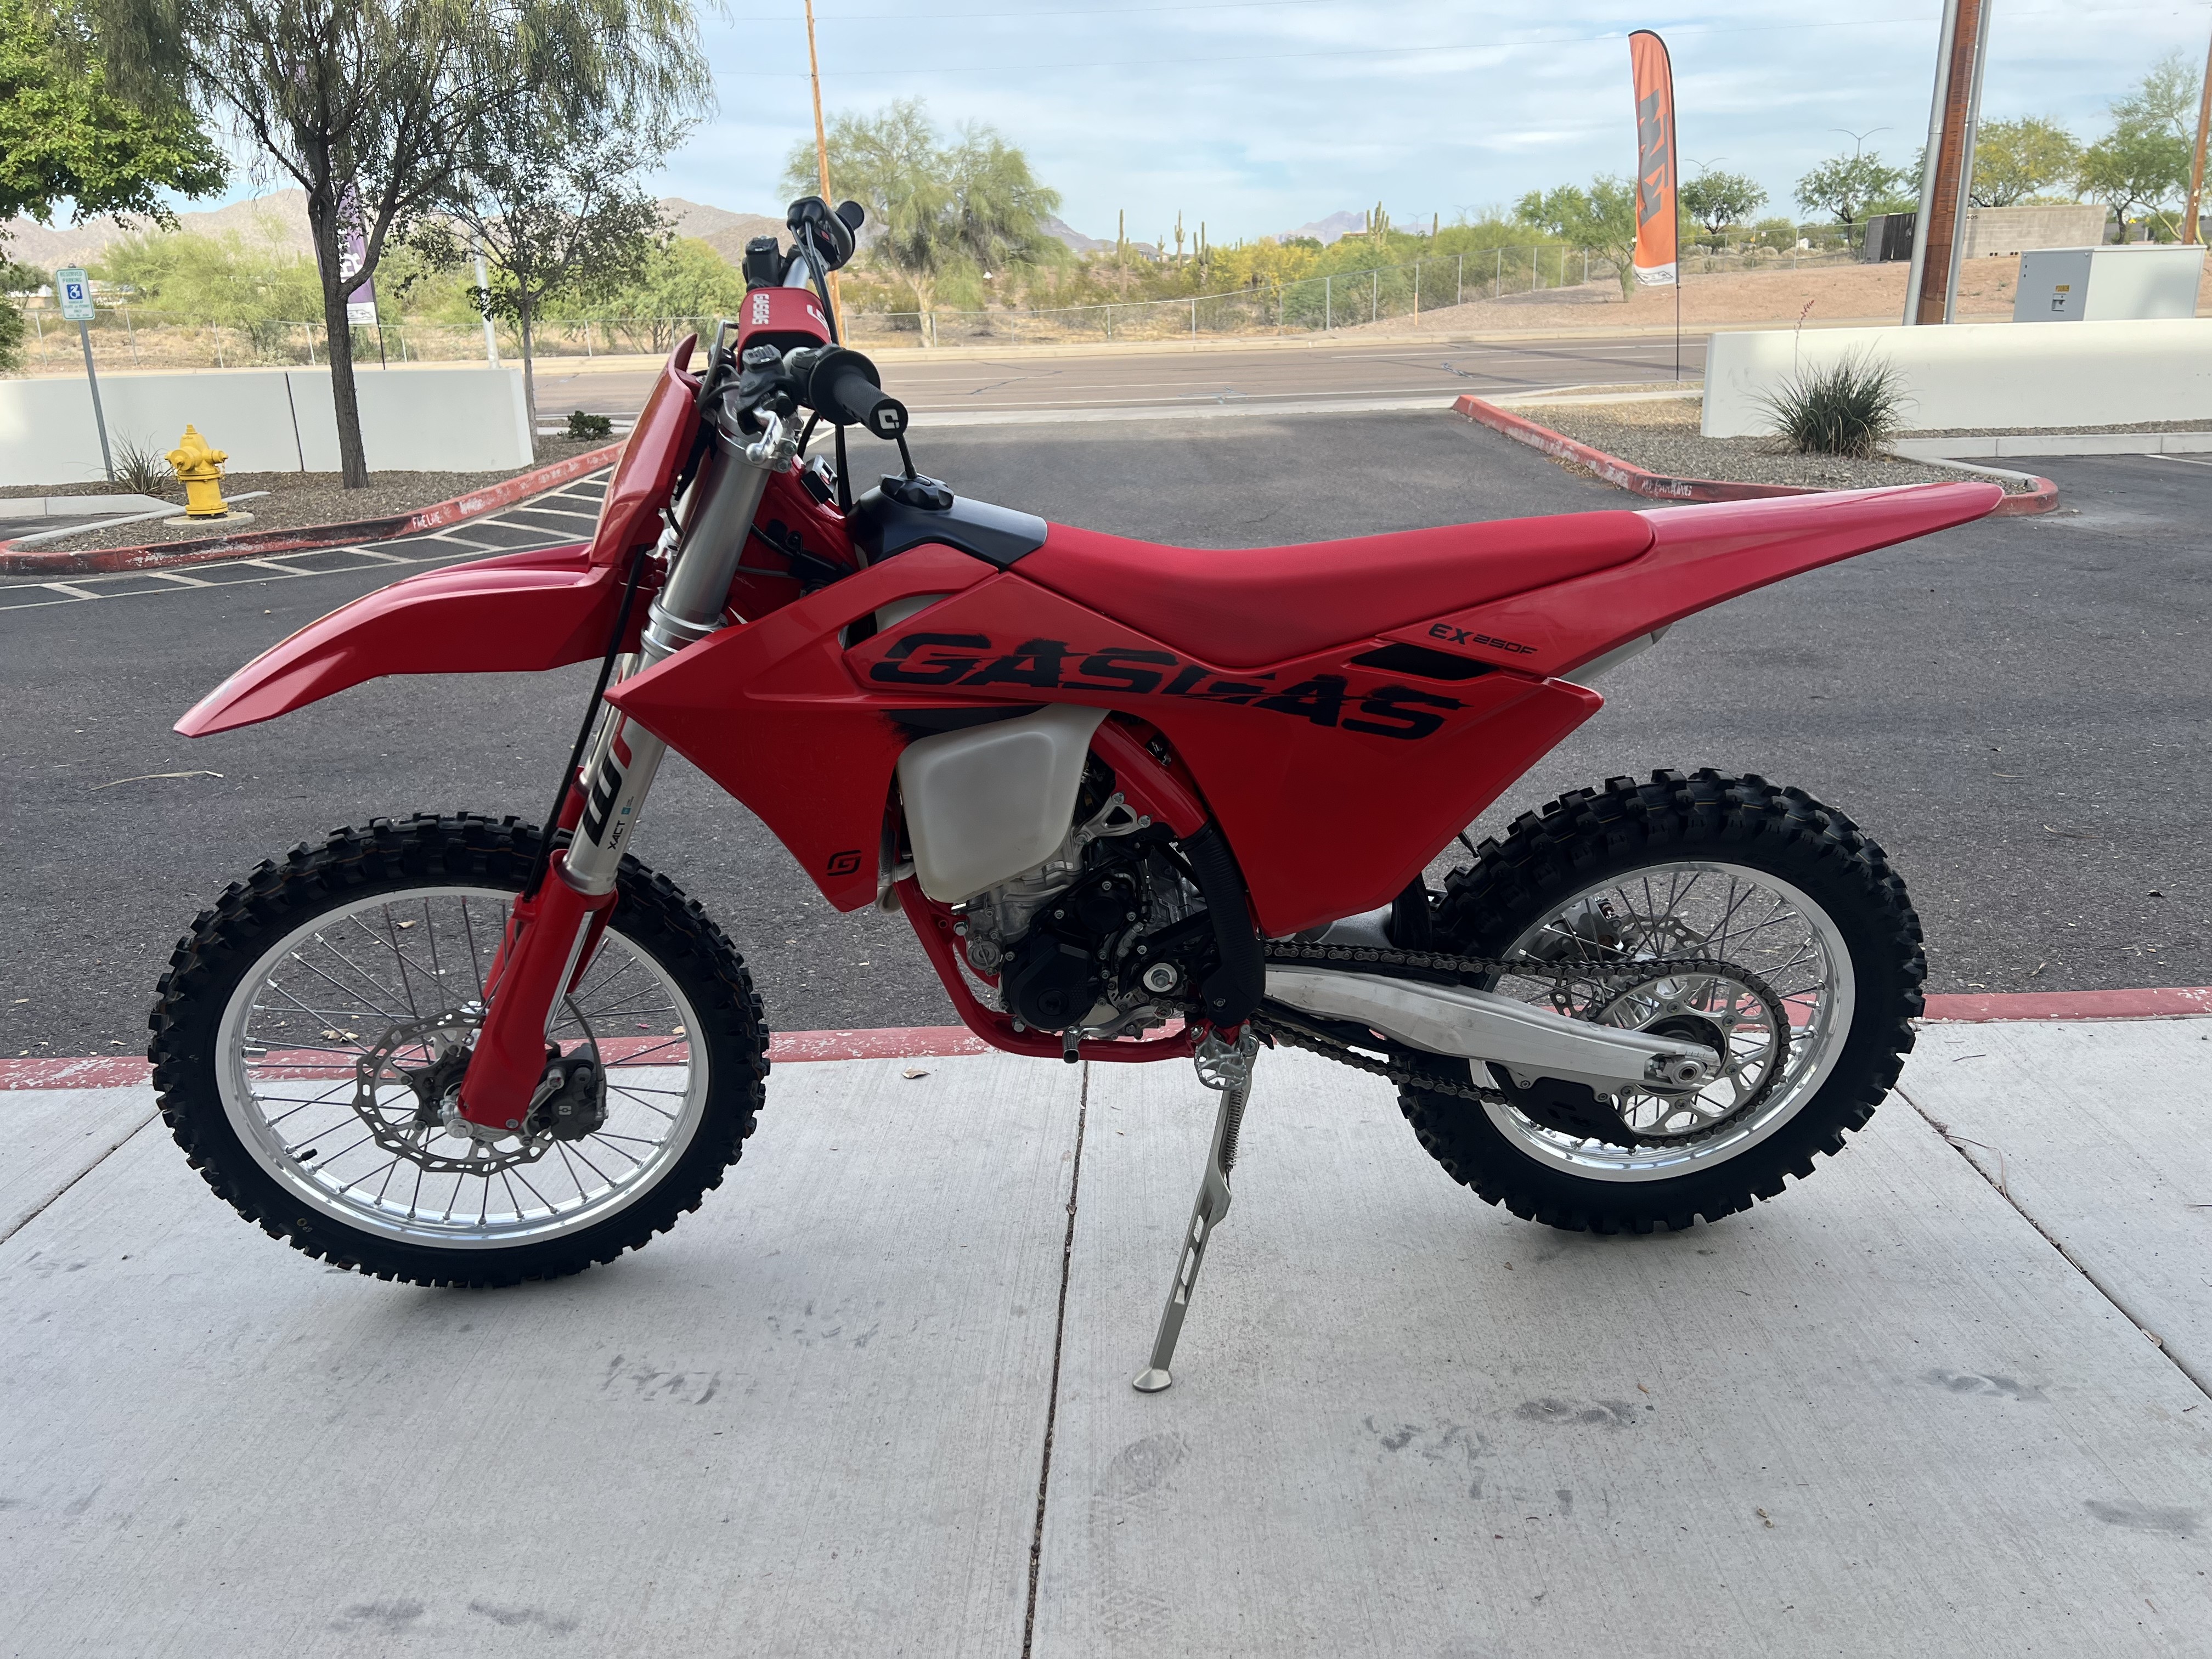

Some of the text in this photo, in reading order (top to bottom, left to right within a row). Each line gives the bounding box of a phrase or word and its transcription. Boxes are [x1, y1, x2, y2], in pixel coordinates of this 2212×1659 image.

[1429, 623, 1538, 654] EX 250F
[870, 633, 1474, 740] GASGAS
[607, 820, 625, 850] XACT
